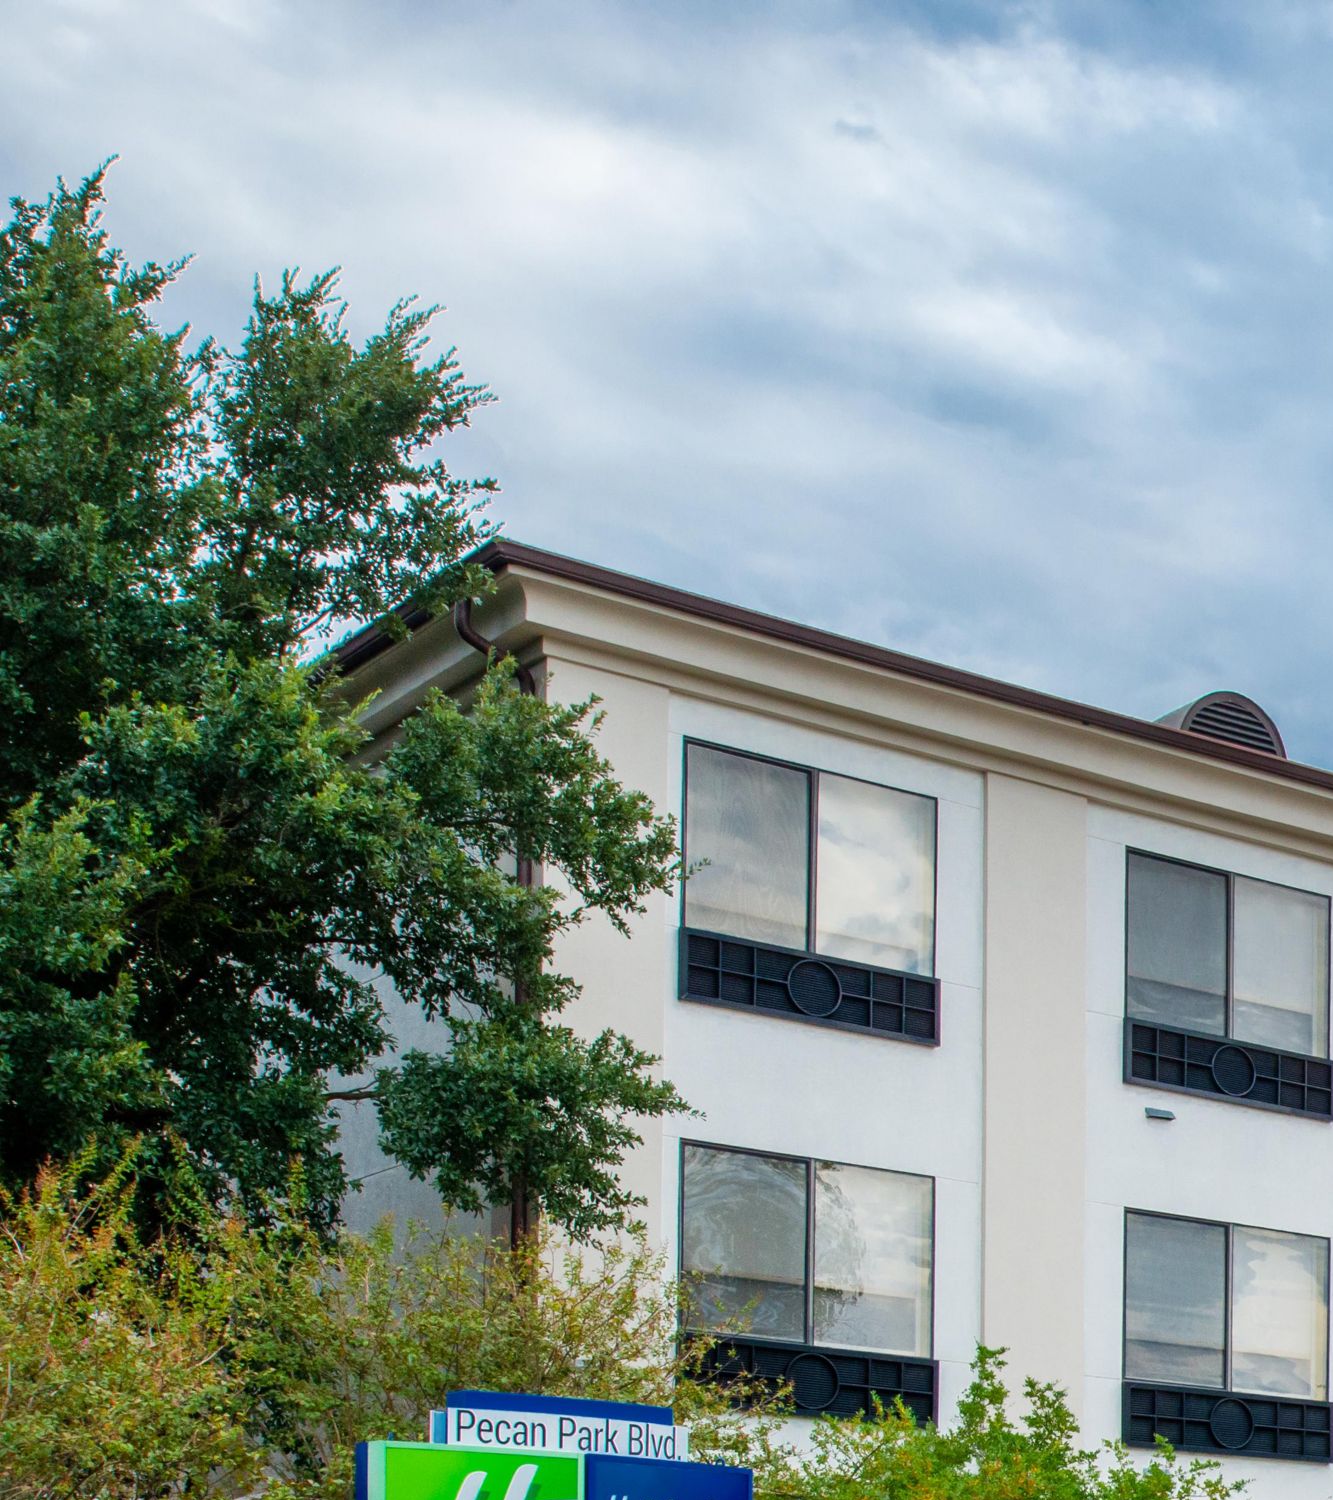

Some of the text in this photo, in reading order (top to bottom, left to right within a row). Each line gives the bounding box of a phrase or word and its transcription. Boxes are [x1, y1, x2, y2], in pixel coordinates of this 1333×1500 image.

[456, 1409, 683, 1461] Pecan Park Blvd.
